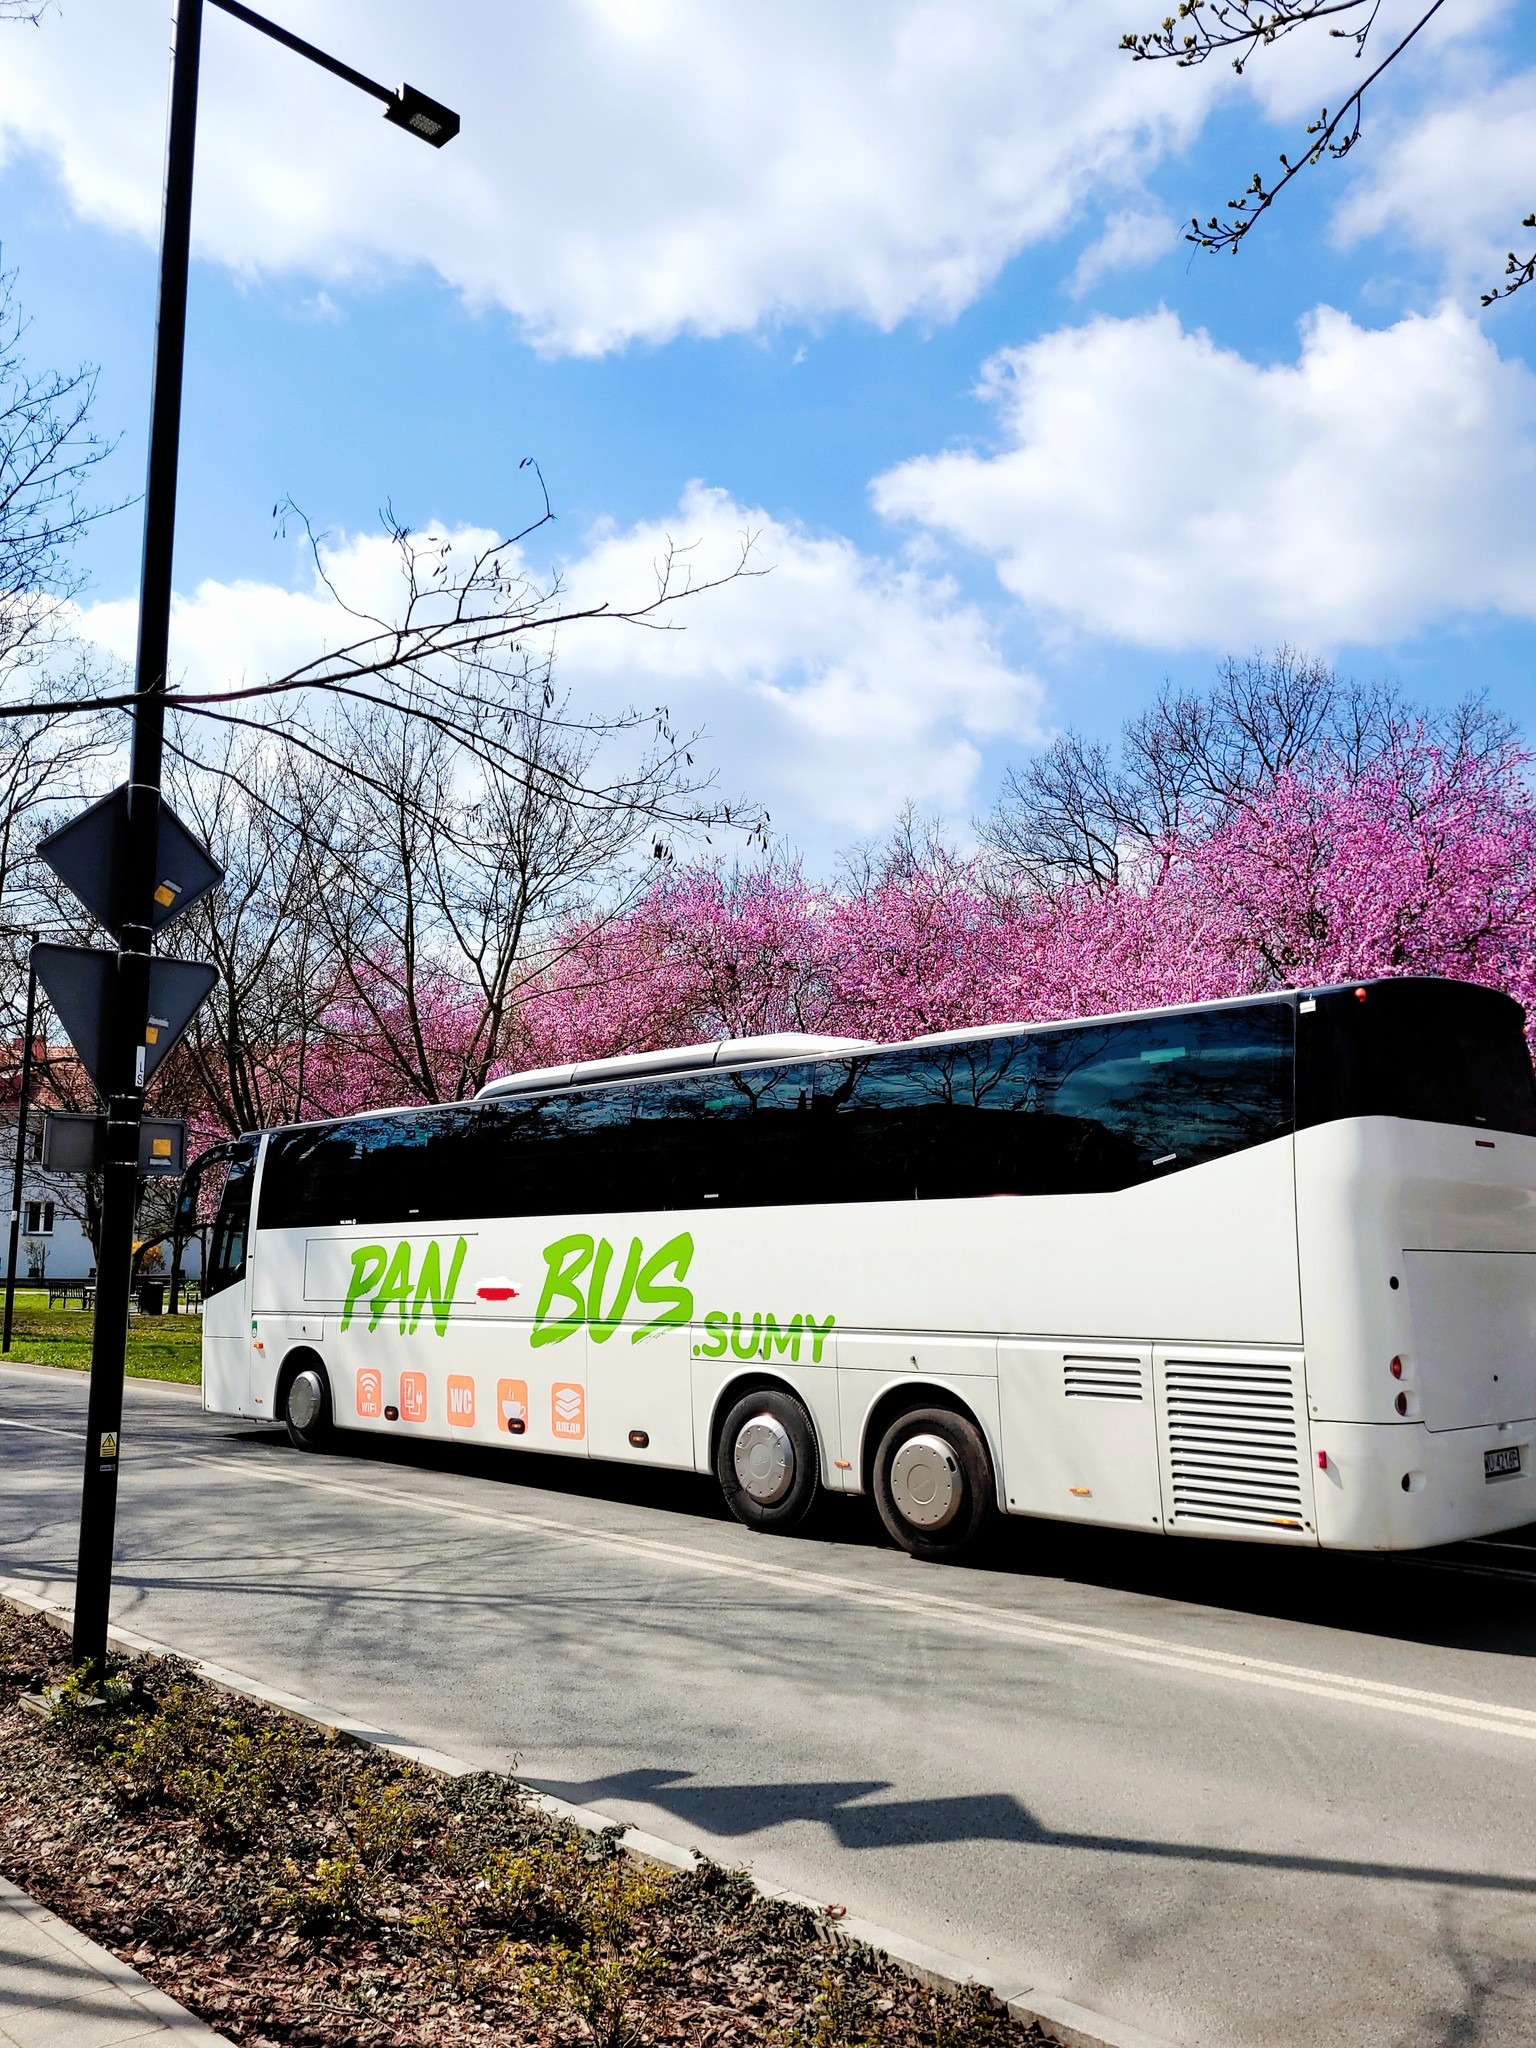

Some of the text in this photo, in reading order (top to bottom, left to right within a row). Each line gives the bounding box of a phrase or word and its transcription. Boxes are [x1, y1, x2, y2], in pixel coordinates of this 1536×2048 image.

[340, 1232, 695, 1348] PAN BUS
[450, 1388, 472, 1414] WC
